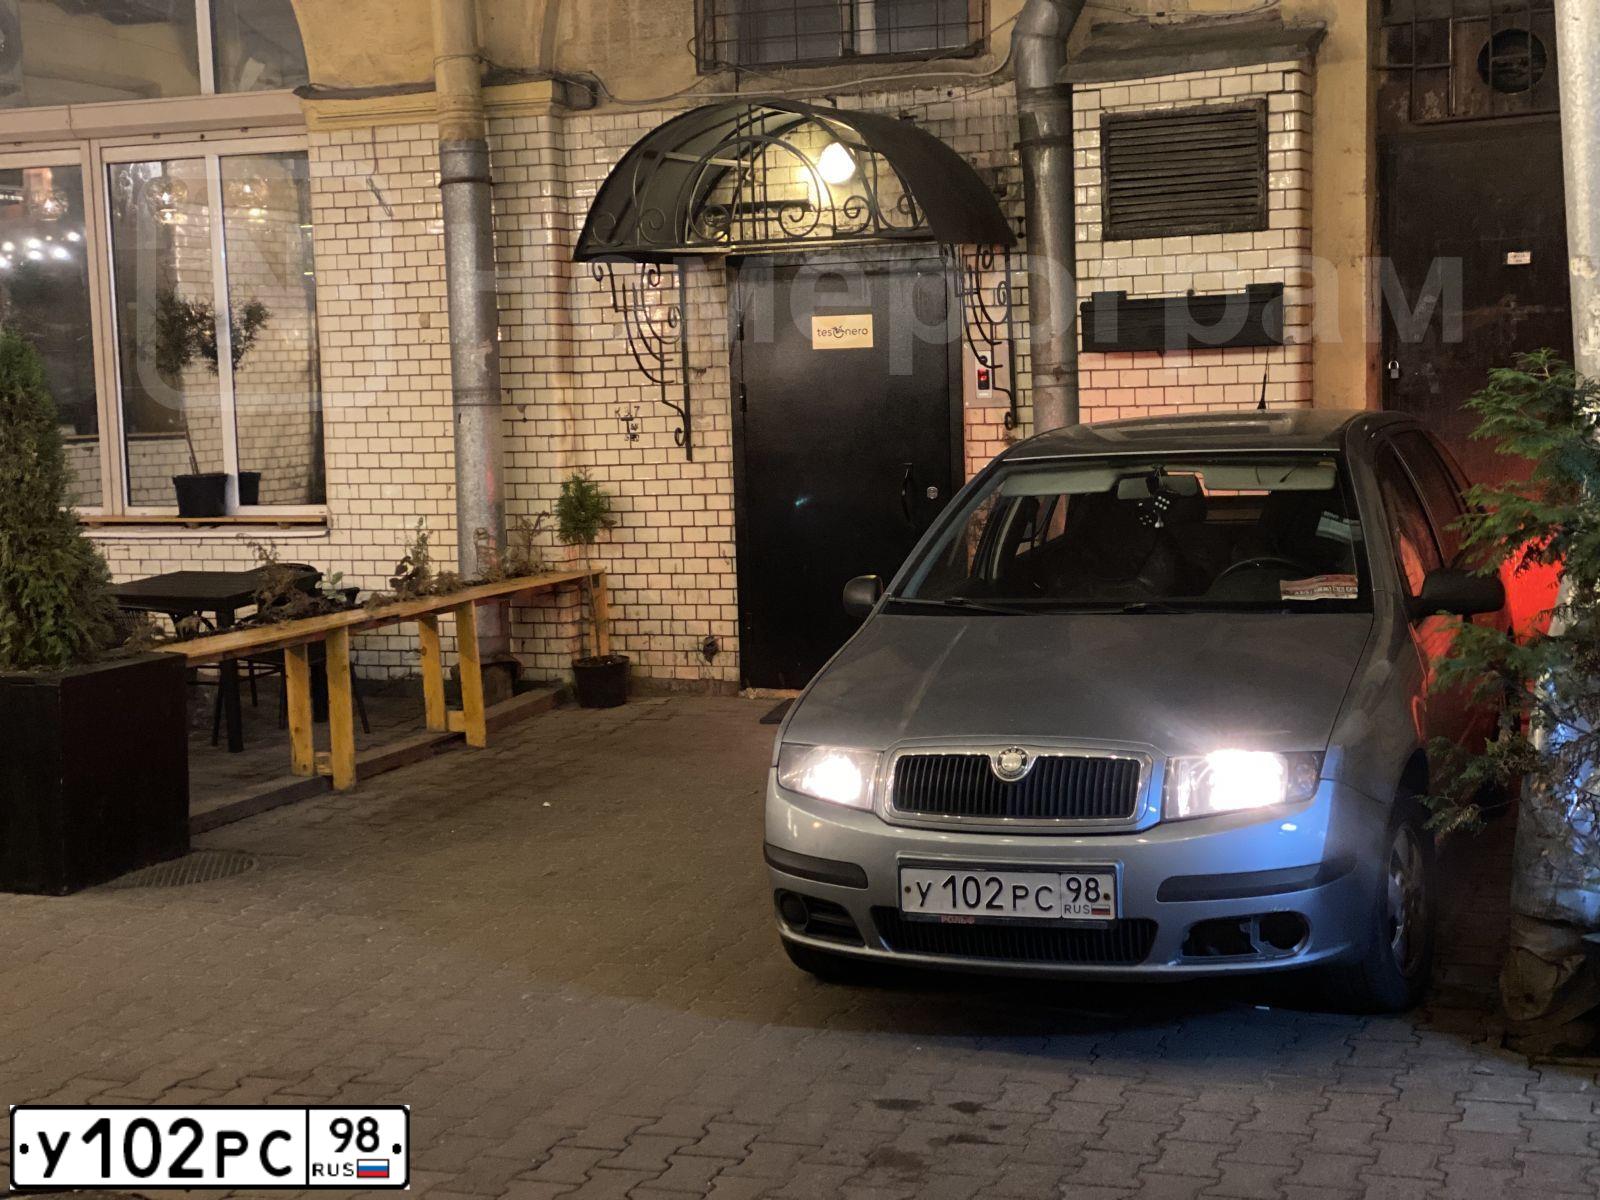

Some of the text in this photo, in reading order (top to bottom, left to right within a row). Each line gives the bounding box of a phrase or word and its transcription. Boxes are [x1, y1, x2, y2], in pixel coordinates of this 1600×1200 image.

[916, 875, 1053, 912] У102РС
[1066, 876, 1100, 903] 98
[1064, 904, 1091, 915] RUS
